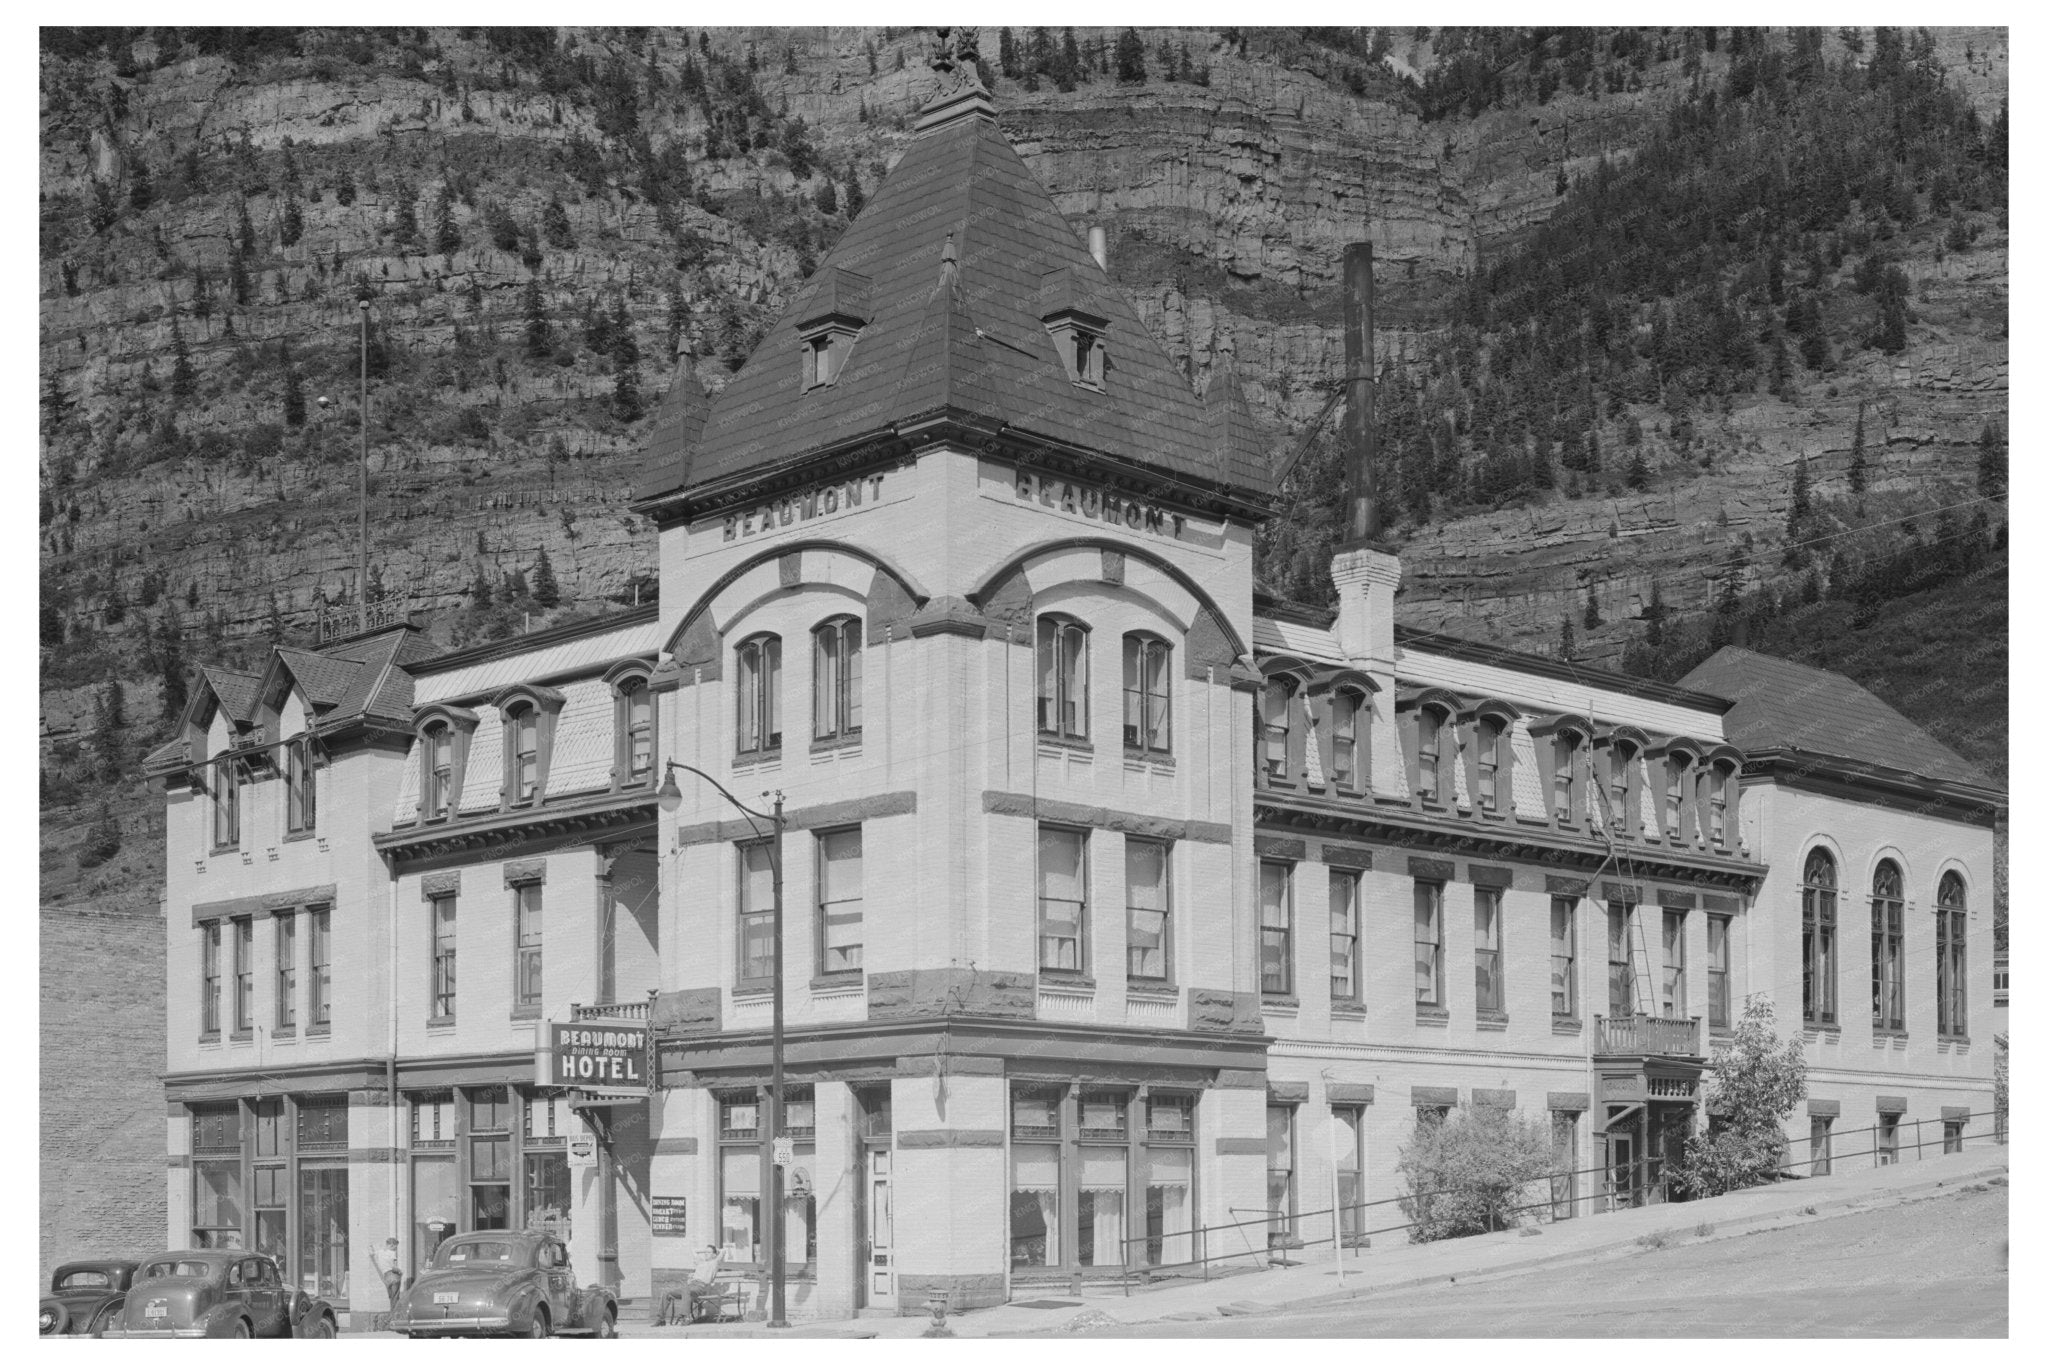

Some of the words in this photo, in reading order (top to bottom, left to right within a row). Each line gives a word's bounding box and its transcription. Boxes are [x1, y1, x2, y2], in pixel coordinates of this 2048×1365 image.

[723, 471, 884, 542] BEAUMONT
[1016, 469, 1186, 539] BEAUMONT
[560, 1030, 645, 1048] BEAUMONT
[572, 1047, 599, 1056] DINING
[603, 1048, 628, 1057] ROOM
[562, 1055, 639, 1079] HOTEL
